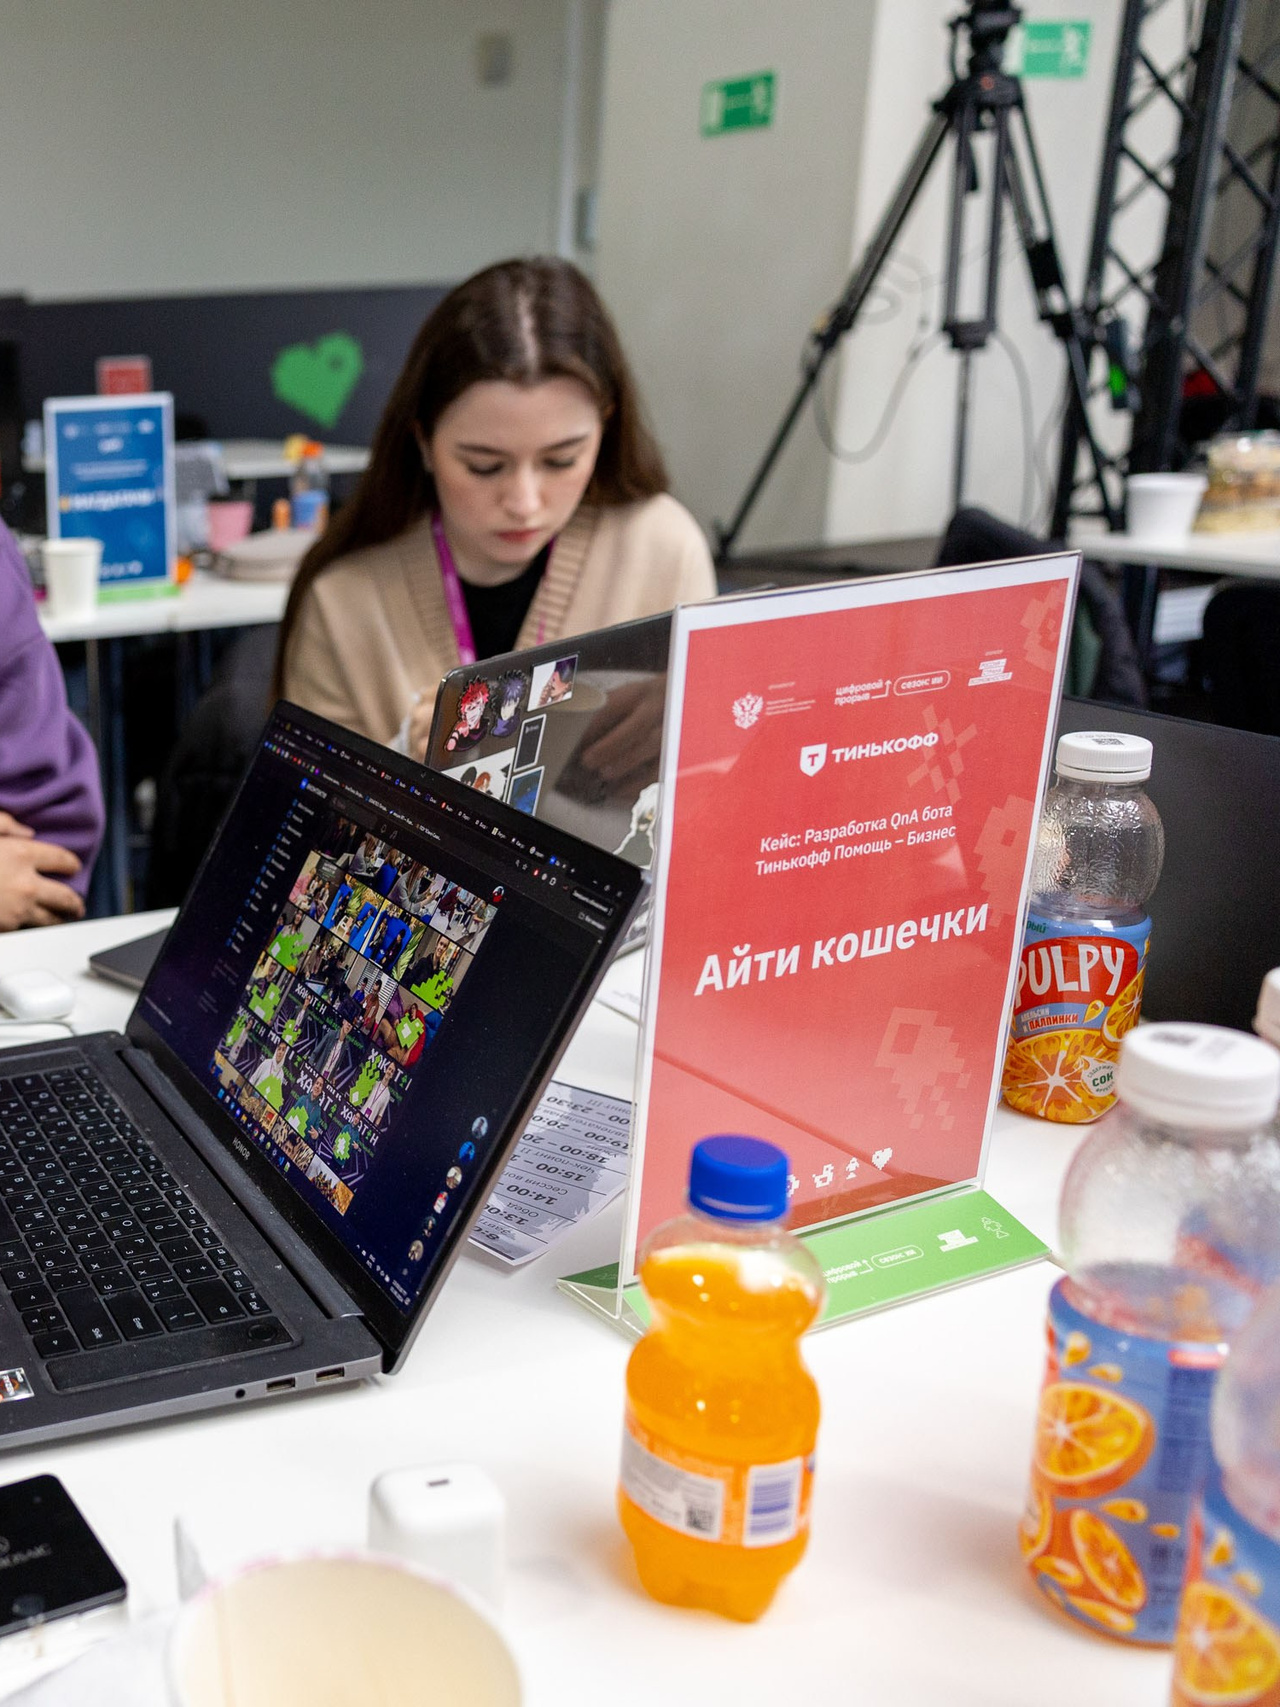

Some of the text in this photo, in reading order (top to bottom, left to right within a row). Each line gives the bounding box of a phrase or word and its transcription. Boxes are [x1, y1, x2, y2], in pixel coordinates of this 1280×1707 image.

[835, 678, 883, 695] цифровой
[834, 692, 870, 706] прорыв
[831, 732, 939, 763] ТИНЬКОФФ
[760, 804, 953, 853] Кейс: Разработка QnA бота
[756, 849, 830, 876] Тинькофф
[834, 839, 892, 861] Помощь
[907, 824, 956, 846] Бизнес
[694, 903, 989, 996] Айти кошечки
[1028, 1013, 1079, 1031] ПАЛПИНКИ
[1092, 1071, 1114, 1087] СОК
[546, 1096, 593, 1113] 23:30
[232, 1136, 251, 1160] HONOR
[560, 1145, 609, 1164] 18:00
[536, 1163, 587, 1182] 15:00
[506, 1184, 558, 1206] 14:00
[525, 1177, 568, 1196] Сессия
[507, 1201, 539, 1218] Обед
